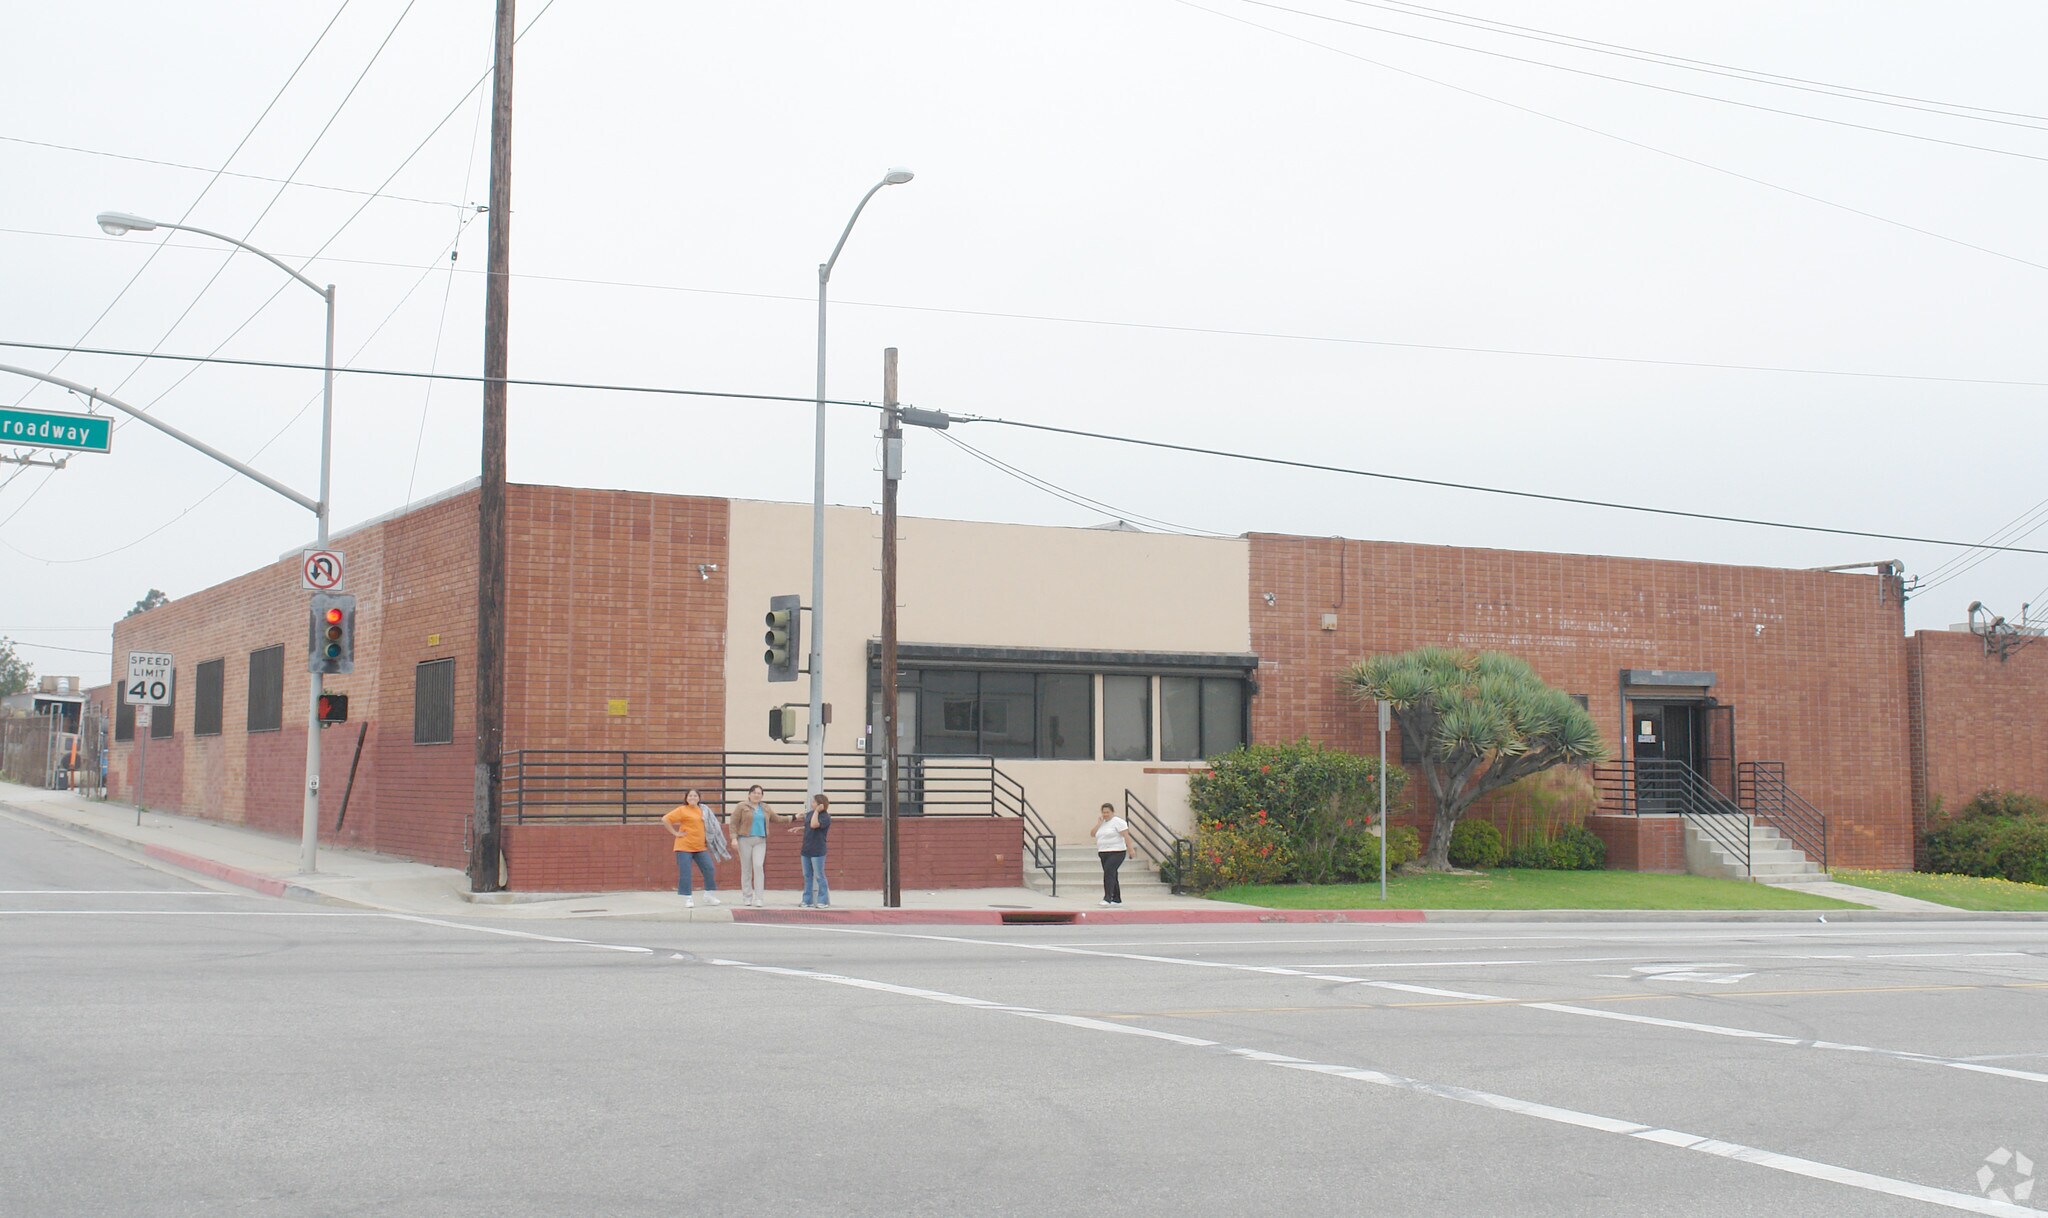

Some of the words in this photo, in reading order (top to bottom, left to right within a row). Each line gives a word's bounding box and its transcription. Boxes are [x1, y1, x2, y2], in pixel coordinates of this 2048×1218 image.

[3, 420, 90, 445] roadway
[131, 656, 170, 666] SPEED
[133, 668, 166, 677] LIMIT
[129, 681, 167, 700] 40
